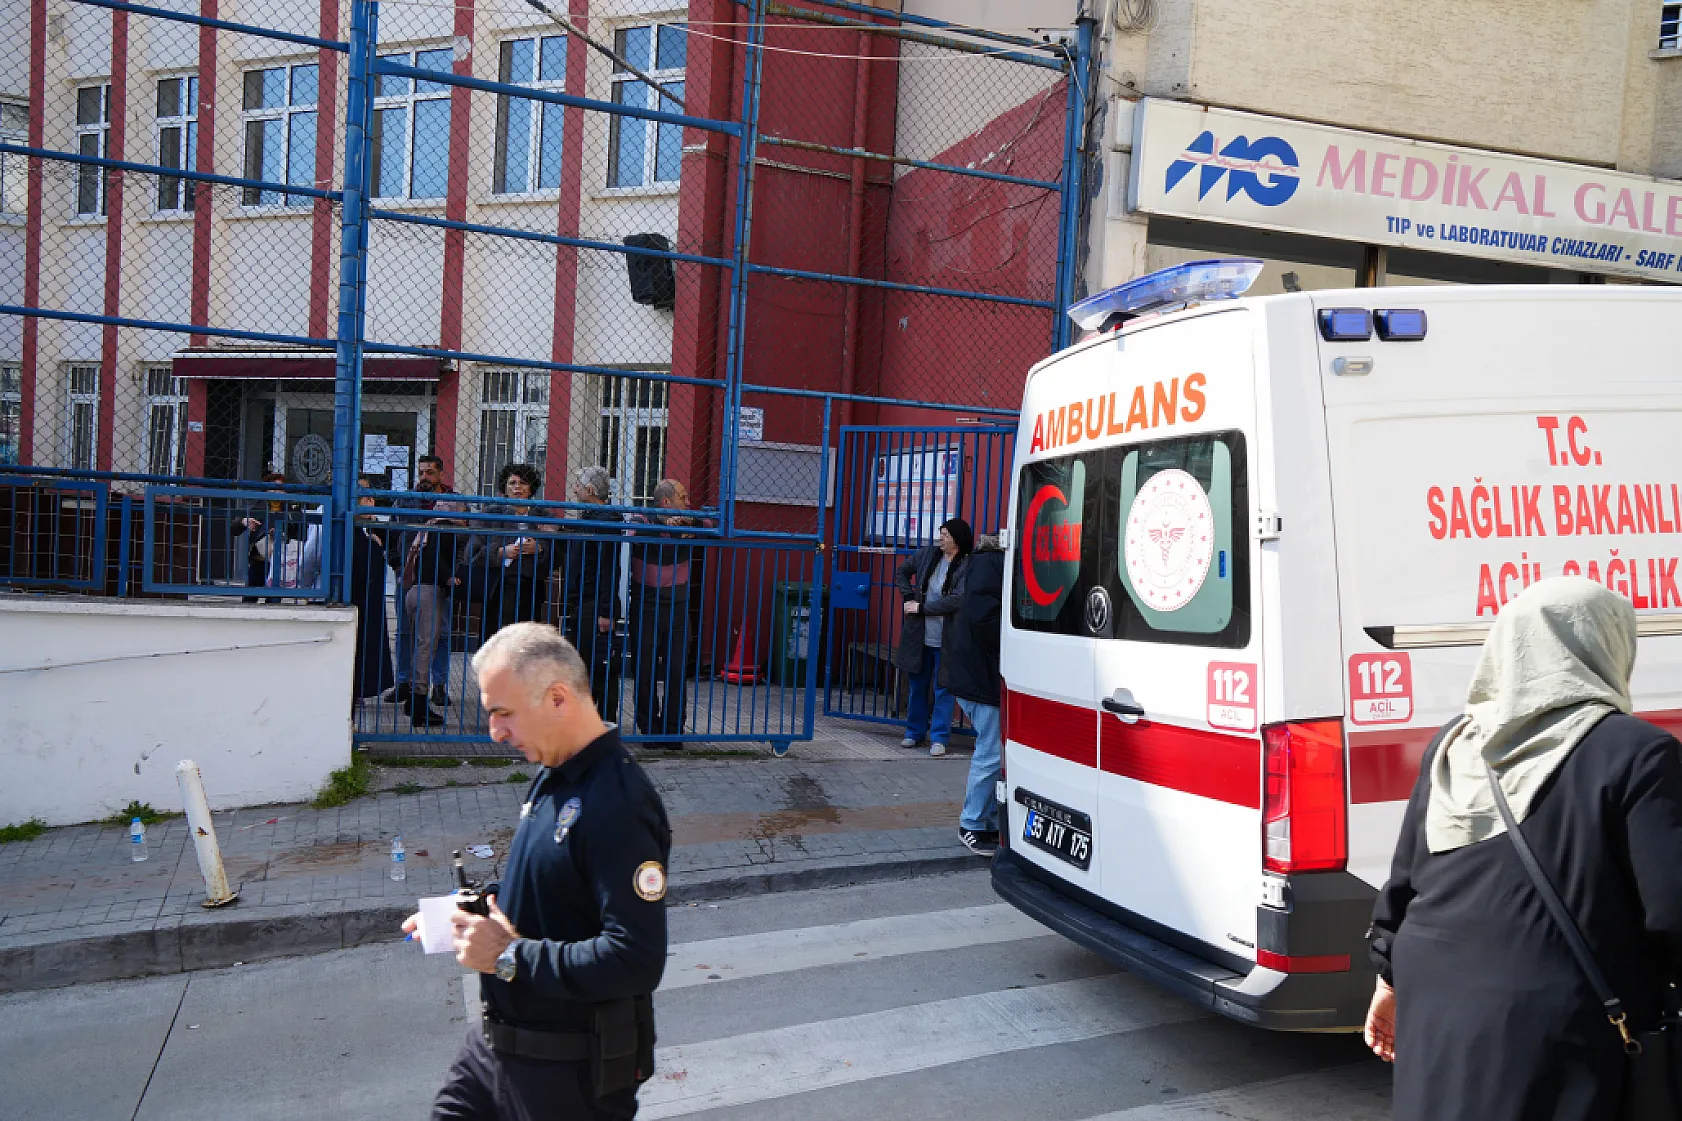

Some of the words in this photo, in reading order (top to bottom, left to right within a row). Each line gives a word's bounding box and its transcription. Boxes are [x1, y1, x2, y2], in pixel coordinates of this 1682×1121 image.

[1316, 144, 1556, 218] MEDİKAL
[1573, 182, 1682, 237] GALE
[1385, 215, 1412, 235] TIP
[1416, 223, 1435, 239] ve
[1440, 223, 1548, 253] LABORATUVAR
[1635, 249, 1676, 271] SARF
[1030, 372, 1207, 455] AMBULANS
[1536, 415, 1603, 467] T.C.
[1426, 476, 1547, 540] SAĞLIK
[1552, 483, 1682, 537] BAKANLI
[1562, 548, 1682, 609] ĞLIK
[1212, 668, 1250, 704] 112
[1357, 660, 1404, 694] 112
